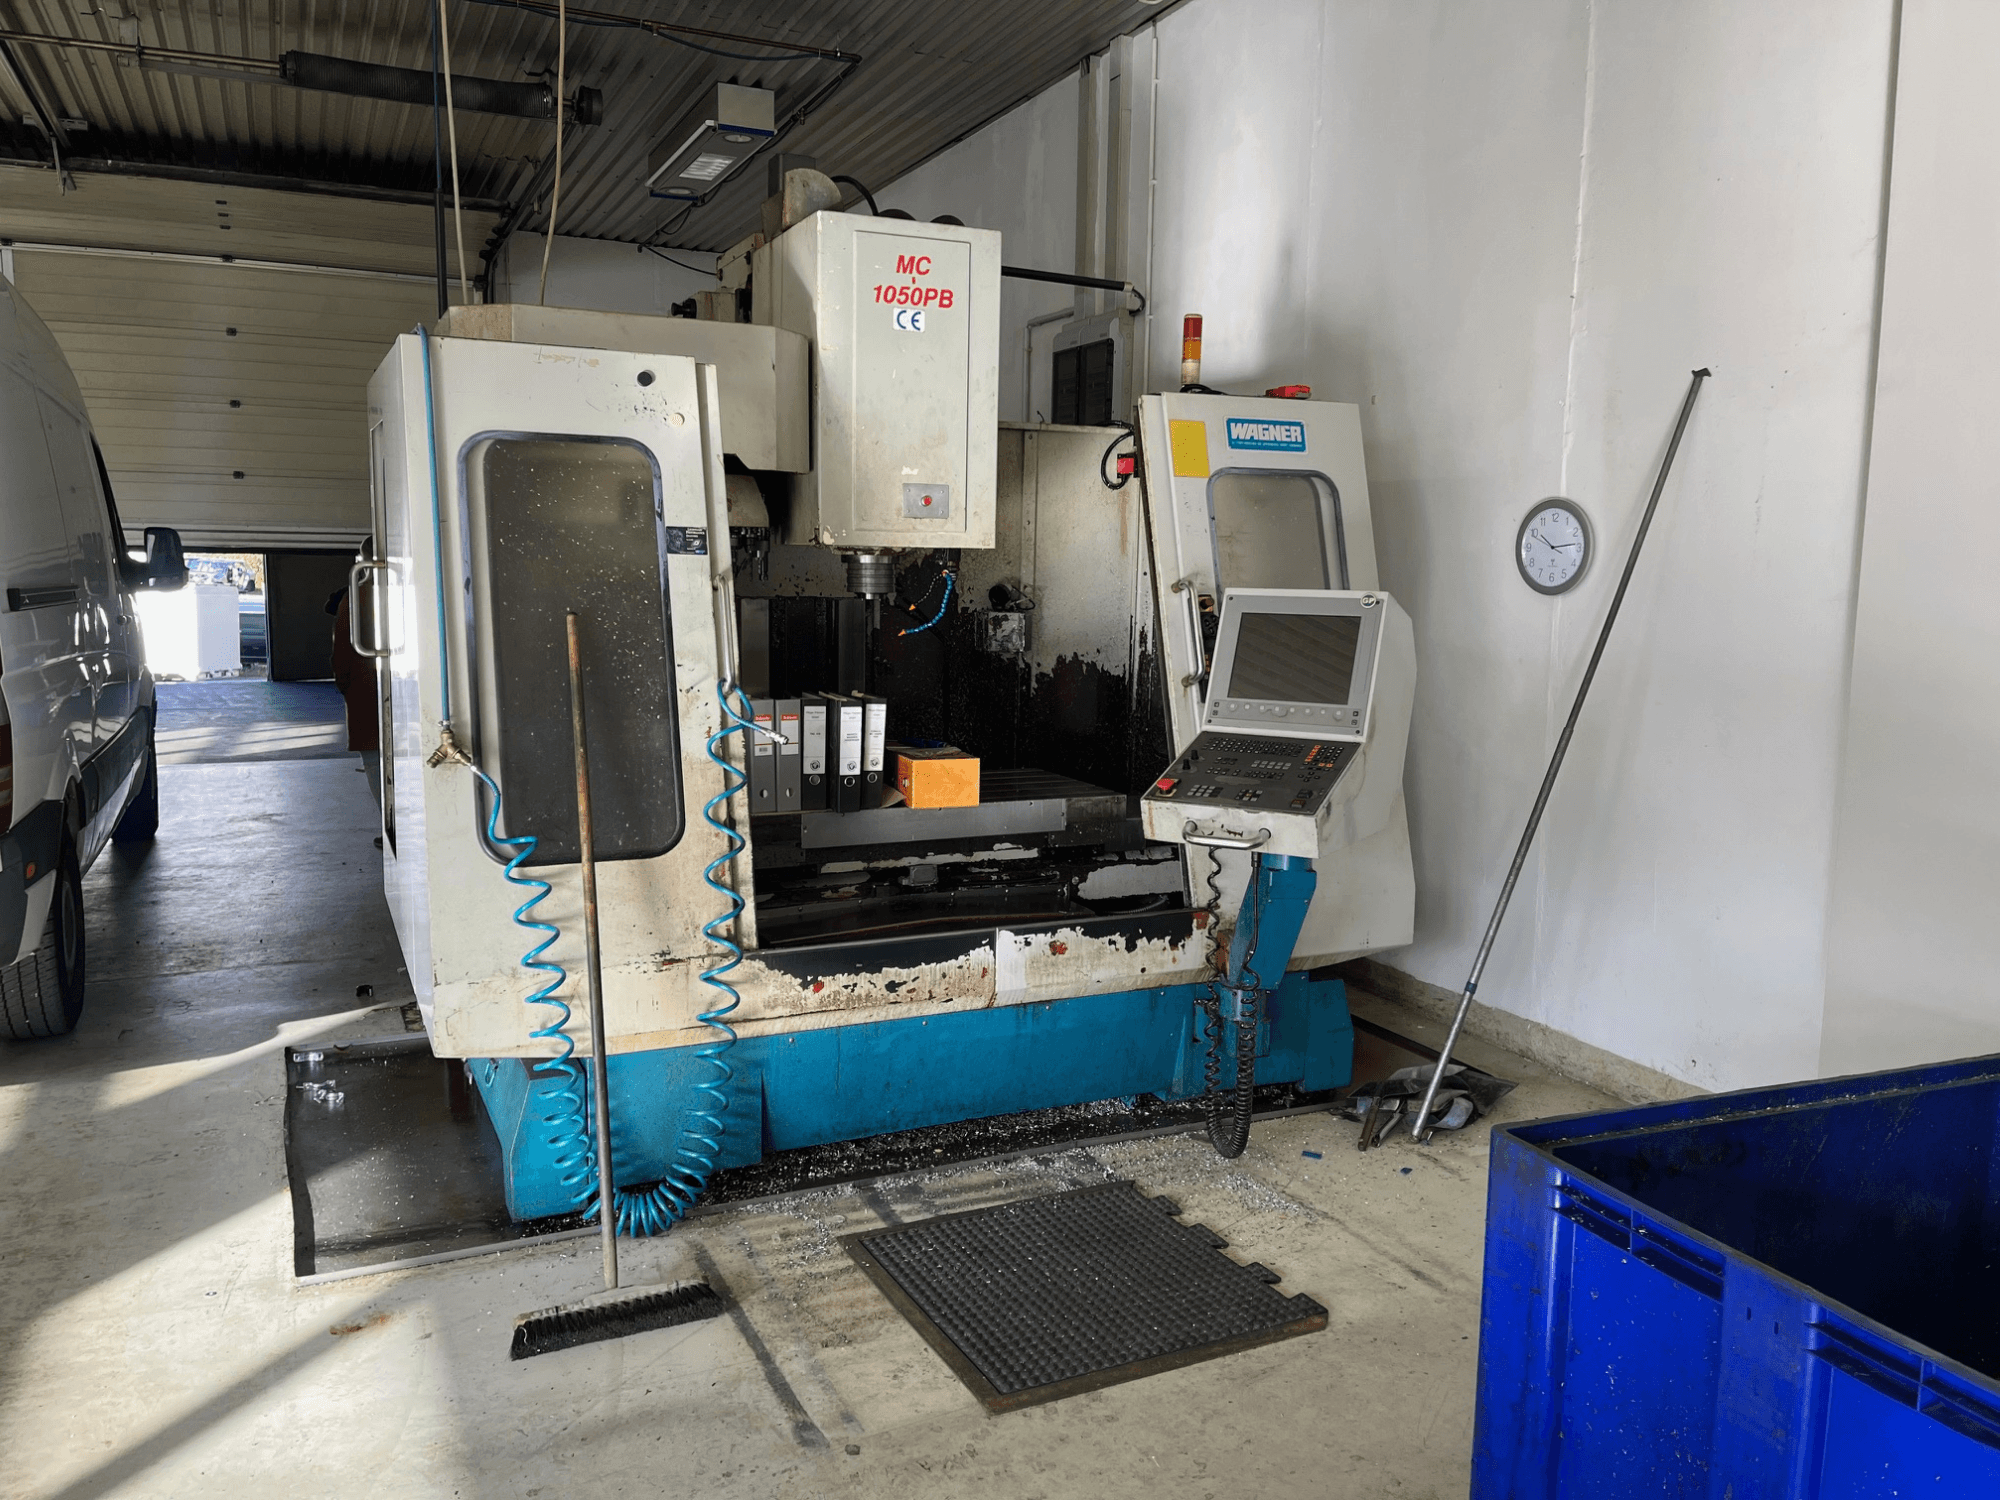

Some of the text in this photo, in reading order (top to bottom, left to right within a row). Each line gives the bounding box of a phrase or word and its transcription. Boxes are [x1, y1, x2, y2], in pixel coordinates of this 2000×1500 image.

[895, 255, 932, 275] MC
[873, 285, 954, 308] 1050PB
[1230, 422, 1302, 443] WAGNER
[1540, 517, 1546, 526] 11
[1552, 512, 1560, 522] 12
[1530, 528, 1539, 538] 10
[1572, 527, 1579, 537] 2
[1526, 543, 1532, 553] 9
[1576, 543, 1582, 553] 3
[1529, 558, 1535, 568] 8
[1571, 559, 1576, 567] 4
[1538, 568, 1544, 578] 7
[1548, 573, 1555, 582] 6
[1561, 568, 1567, 579] 5
